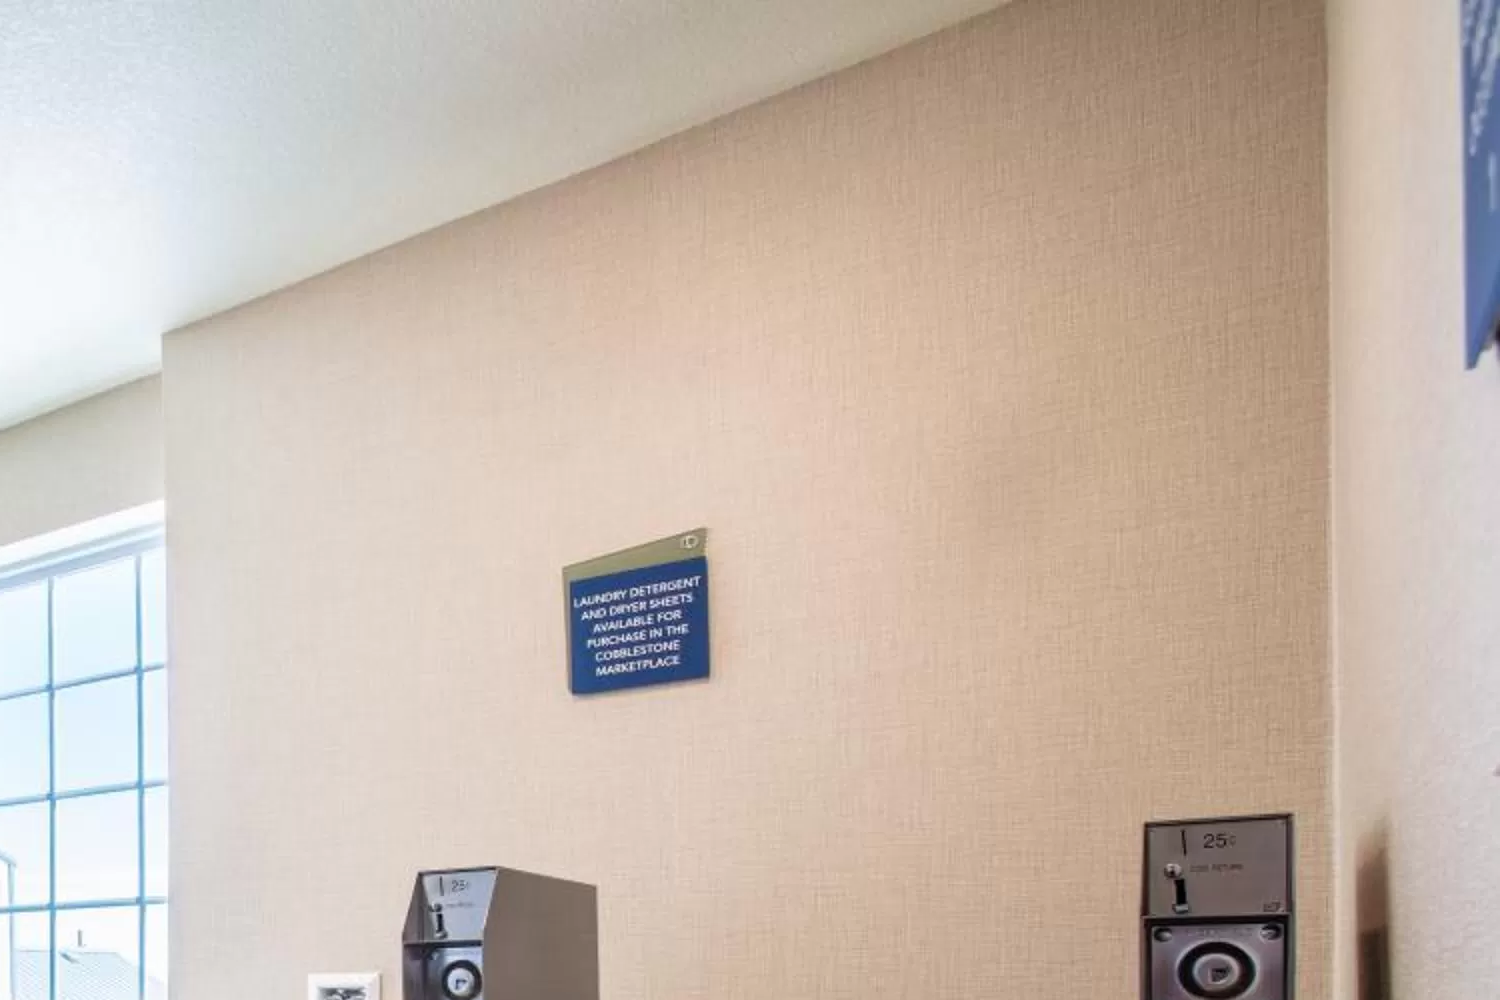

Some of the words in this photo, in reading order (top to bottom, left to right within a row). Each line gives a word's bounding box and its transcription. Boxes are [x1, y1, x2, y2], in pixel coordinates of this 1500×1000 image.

[573, 589, 628, 608] LAUNDRY
[629, 575, 702, 599] DETERGENT
[581, 608, 607, 621] AND
[609, 599, 647, 616] DRYER
[649, 592, 694, 609] SHEETS
[593, 613, 655, 634] AVAILABLE
[657, 609, 683, 622] FOR
[586, 629, 648, 649] PURCHASE
[649, 627, 663, 639] IN
[667, 623, 690, 635] THE
[595, 640, 681, 662] COBBLESTONE
[595, 655, 681, 677] MARKETPLACE
